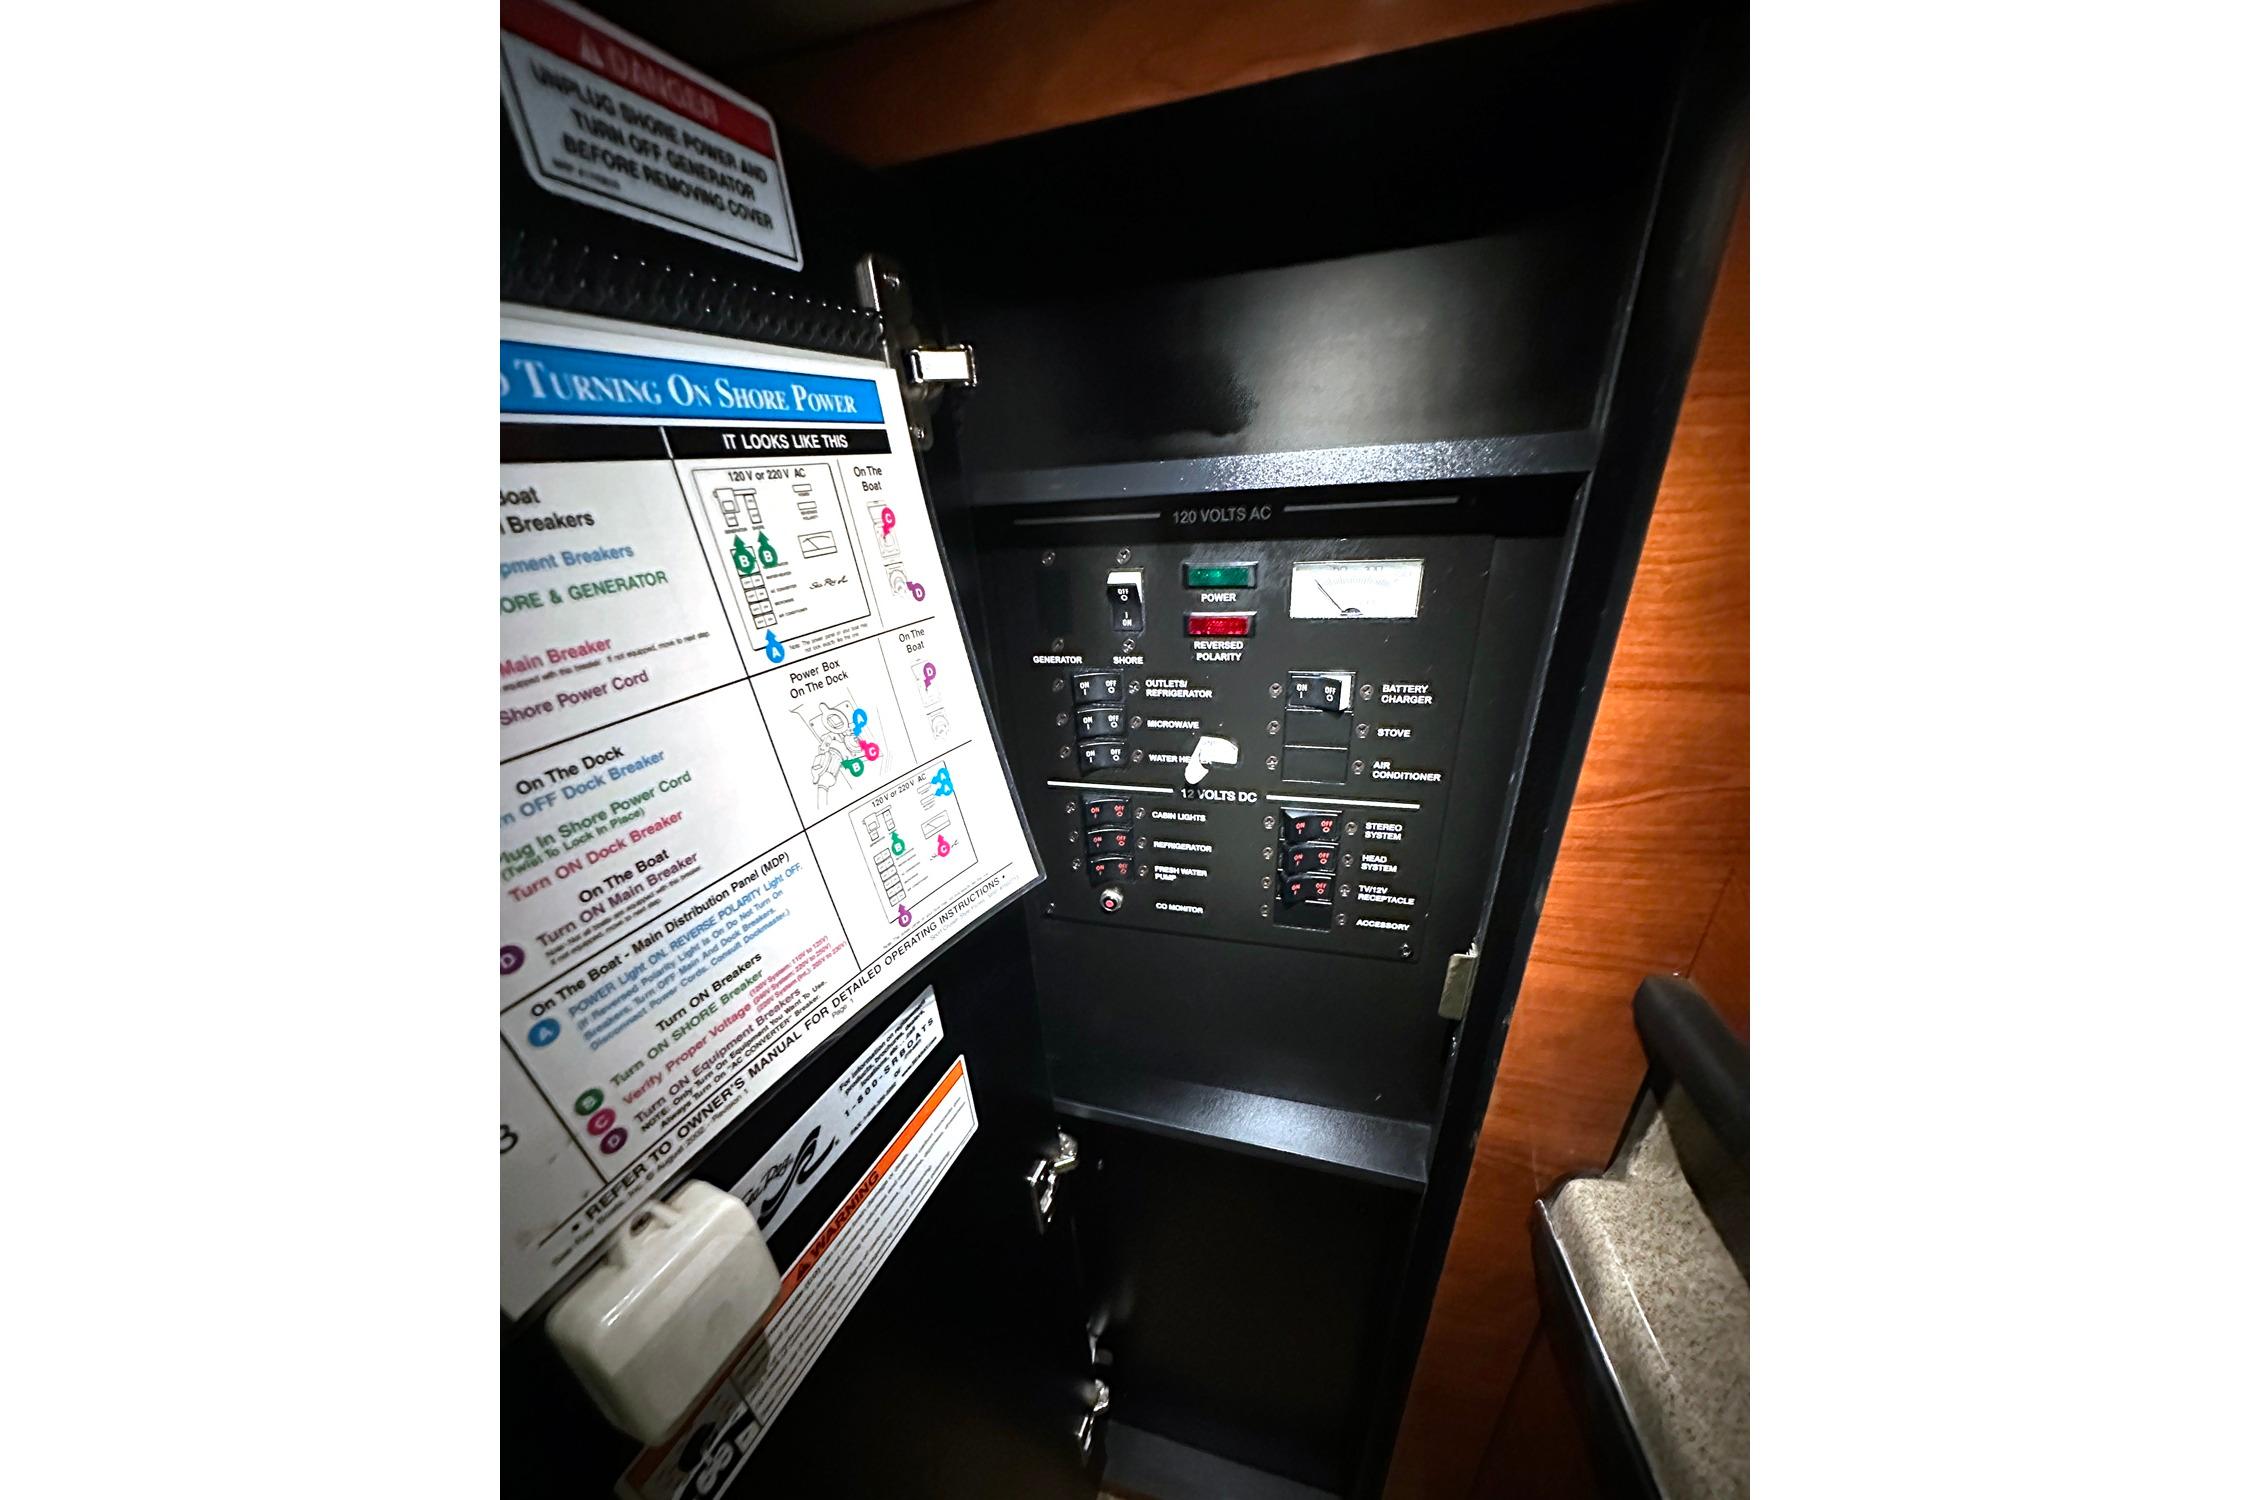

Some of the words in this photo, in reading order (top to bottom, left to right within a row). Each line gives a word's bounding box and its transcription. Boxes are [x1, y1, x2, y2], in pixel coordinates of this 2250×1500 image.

[570, 107, 623, 147] TURN
[629, 133, 661, 160] OFF
[667, 149, 756, 201] GENERATOR
[682, 130, 738, 168] POWER
[562, 131, 639, 179] BEFORE
[727, 198, 774, 230] COVER
[722, 434, 736, 449] IT
[741, 435, 789, 449] LOOKS
[792, 435, 821, 449] LIKE
[822, 435, 848, 448] THIS
[729, 471, 745, 482] 120
[746, 471, 753, 481] V
[755, 472, 764, 480] or
[767, 469, 782, 480] 220
[783, 469, 789, 478] V
[794, 468, 806, 478] AC
[854, 467, 866, 477] On
[867, 466, 882, 475] The
[862, 481, 882, 491] Boat
[1172, 511, 1197, 524] 120
[1201, 507, 1246, 522] VOLTS
[1250, 505, 1272, 520] AC
[507, 512, 595, 534] Breakers
[1201, 593, 1236, 602] POWER
[899, 634, 910, 642] On
[910, 629, 925, 638] The
[906, 641, 924, 653] Boat
[1194, 641, 1243, 650] REVERSED
[500, 656, 544, 676] Main
[546, 638, 611, 664] Breaker
[1033, 656, 1082, 664] GENERATOR
[1113, 656, 1144, 665] SHORE
[1196, 652, 1242, 661] POLARITY
[790, 667, 818, 683] Power
[822, 660, 840, 672] Box
[790, 687, 805, 699] On
[807, 680, 824, 692] The
[826, 671, 848, 686] Dock
[1146, 680, 1188, 688] OUTLETS/
[1382, 684, 1429, 693] BATTERY
[1146, 689, 1212, 698] REFRIGERATOR
[1325, 686, 1336, 694] OFF
[500, 700, 553, 725] Shore
[557, 683, 607, 708] Power
[612, 670, 649, 691] Cord
[1381, 694, 1432, 704] CHARGER
[1147, 720, 1199, 729] MICROWAVE
[1377, 728, 1411, 737] STOVE
[1149, 755, 1178, 763] WATER
[1373, 761, 1390, 769] AIR
[516, 778, 544, 795] On
[544, 764, 579, 784] The
[581, 747, 624, 769] Dock
[1373, 771, 1441, 781] CONDITIONER
[520, 793, 557, 817] OFF
[562, 776, 606, 800] Dock
[608, 751, 664, 781] Breaker
[1181, 789, 1195, 799] 12
[1198, 790, 1238, 801] VOLTS
[1241, 793, 1257, 803] DC
[500, 844, 535, 863] lug
[558, 811, 608, 838] Shore
[610, 790, 655, 815] Power
[658, 771, 691, 793] Cord
[1152, 811, 1176, 820] CABIN
[1178, 814, 1206, 822] LIGHTS
[1321, 820, 1333, 828] OFF
[1366, 822, 1402, 831] STEREO
[1365, 831, 1401, 840] SYSTEM
[1154, 841, 1212, 852] REFRIGERATOR
[509, 875, 552, 902] Turn
[555, 859, 583, 879] ON
[585, 839, 627, 864] Dock
[629, 810, 683, 843] Breaker
[1362, 854, 1387, 863] HEAD
[1154, 866, 1179, 874] FRESH
[1181, 868, 1207, 877] WATER
[1361, 863, 1397, 872] SYSTEM
[578, 887, 603, 903] On
[604, 869, 633, 890] The
[636, 849, 670, 873] Boat
[1155, 873, 1177, 881] PUMP
[1358, 885, 1388, 894] TV/12V
[536, 920, 577, 947] Turn
[579, 903, 606, 923] ON
[608, 883, 645, 908] Main
[646, 852, 698, 886] Breaker
[1358, 894, 1415, 905] RECEPTACLE
[1169, 903, 1203, 914] MONITOR
[1356, 919, 1410, 930] ACCESSORY
[531, 999, 556, 1016] On
[555, 979, 586, 1001] The
[588, 955, 623, 981] Boat
[632, 931, 663, 953] Main
[665, 889, 730, 934] Distribution
[731, 871, 759, 892] Panel
[761, 852, 790, 876] (MDP)
[656, 1007, 687, 1031] Turn
[689, 989, 710, 1008] ON
[712, 952, 762, 991] Breakers
[610, 1060, 644, 1086] Turn
[647, 1039, 669, 1059] ON
[672, 1002, 719, 1042] SHORE
[720, 970, 763, 1006] Breaker
[585, 1163, 648, 1221] REFER
[649, 1141, 672, 1164] TO
[678, 1078, 746, 1139] OWNER'S
[748, 1031, 802, 1078] MANUAL
[804, 1006, 829, 1031] FOR
[832, 964, 882, 1008] DETAILED
[885, 923, 938, 966] OPERATING
[939, 877, 1000, 925] INSTRUCTIONS
[622, 1072, 663, 1104] Verify
[665, 1036, 708, 1072] Proper
[708, 1003, 751, 1038] Voltage
[634, 1098, 665, 1122] Turn
[669, 1076, 690, 1096] ON
[692, 1025, 755, 1078] Equipment
[755, 988, 800, 1026] Breakers
[811, 1171, 879, 1256] WARNING
